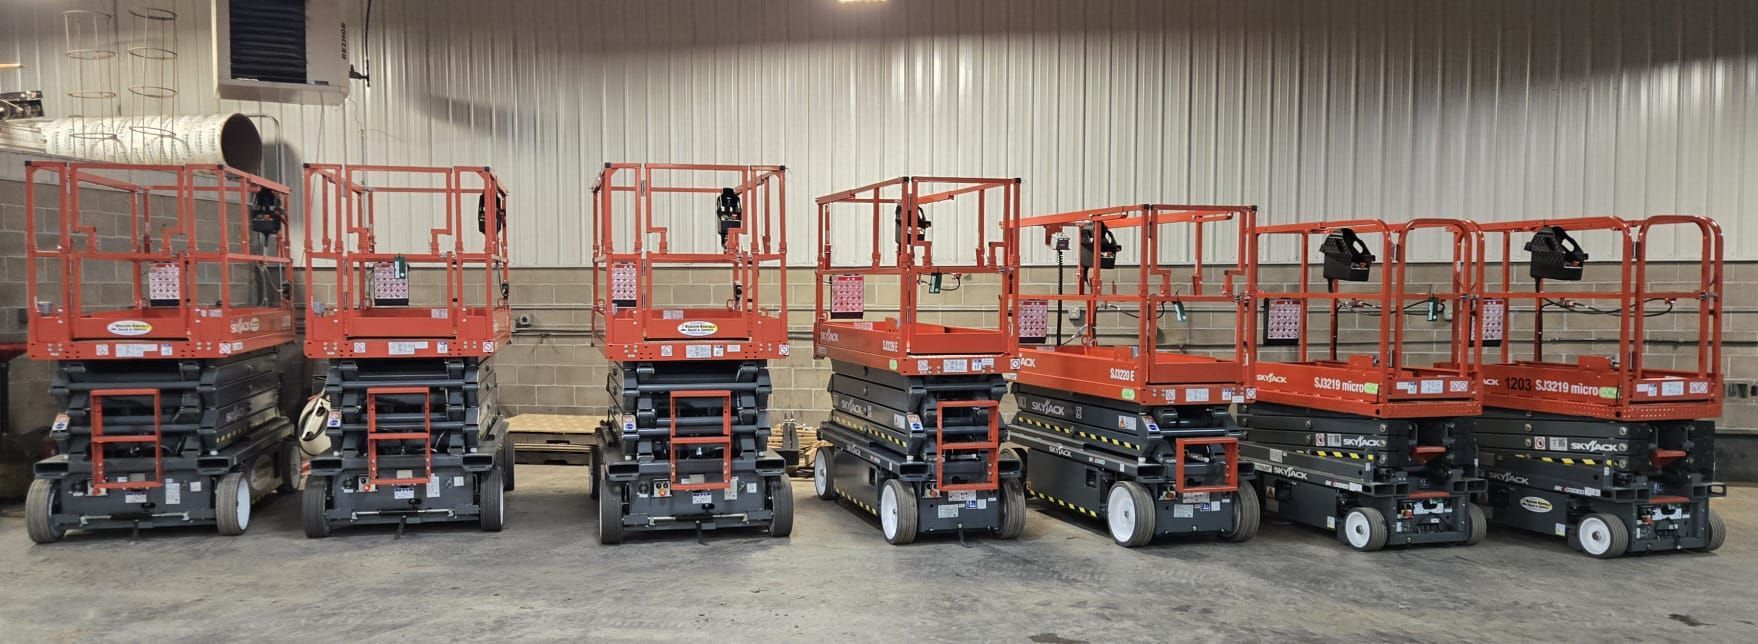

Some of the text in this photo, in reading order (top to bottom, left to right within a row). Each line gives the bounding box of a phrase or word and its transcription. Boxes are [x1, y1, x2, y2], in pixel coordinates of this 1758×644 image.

[1256, 373, 1287, 383] SKYJACK
[1314, 377, 1341, 390] SJ3219
[1342, 381, 1364, 393] micro
[1505, 377, 1532, 391] 1203
[1535, 379, 1569, 393] SJ3219
[1570, 383, 1599, 396] micro
[1032, 400, 1065, 416] SKYJACK
[1343, 435, 1381, 448] SKYJACK
[1570, 440, 1618, 452] SKYJACK
[1273, 466, 1308, 480] SKYJACK
[1488, 472, 1529, 485] SKYJACK
